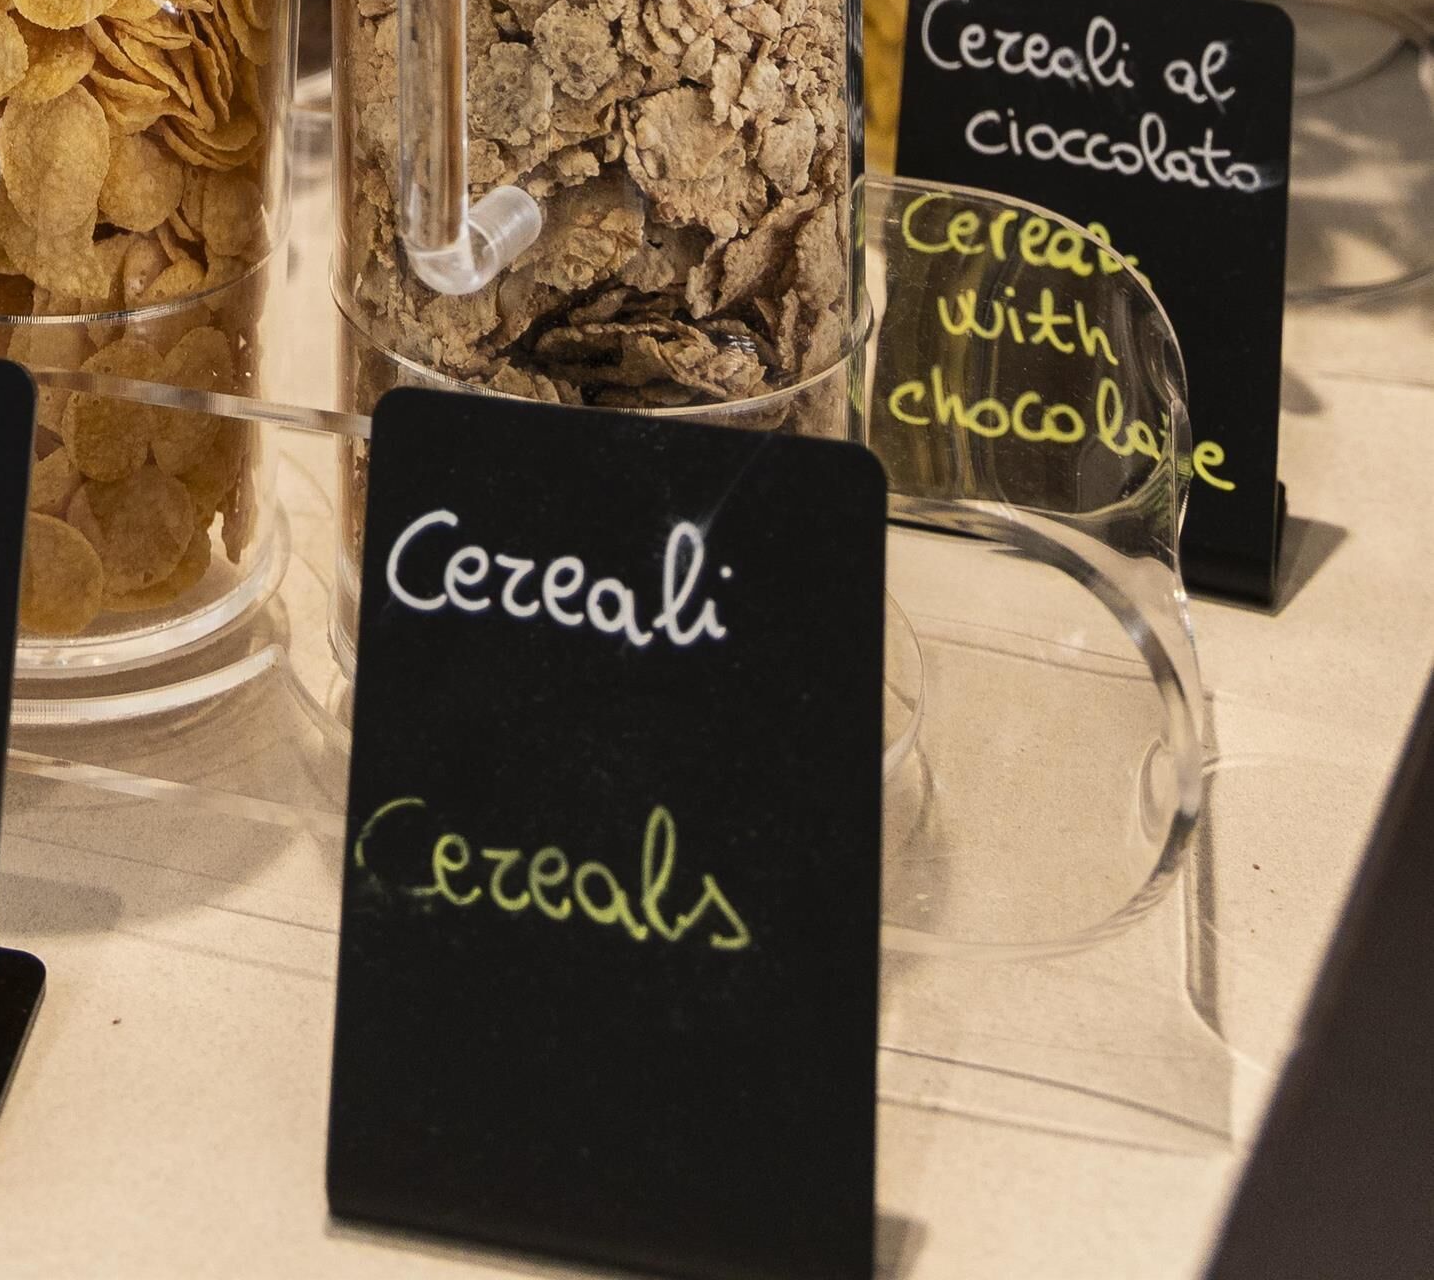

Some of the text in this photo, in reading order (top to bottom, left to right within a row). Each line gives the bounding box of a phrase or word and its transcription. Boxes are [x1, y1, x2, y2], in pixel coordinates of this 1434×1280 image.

[1164, 41, 1236, 103] al
[965, 108, 1262, 193] cioccolato
[889, 365, 1236, 492] chocolae
[386, 509, 734, 646] Cereali
[355, 797, 752, 951] Cereals
